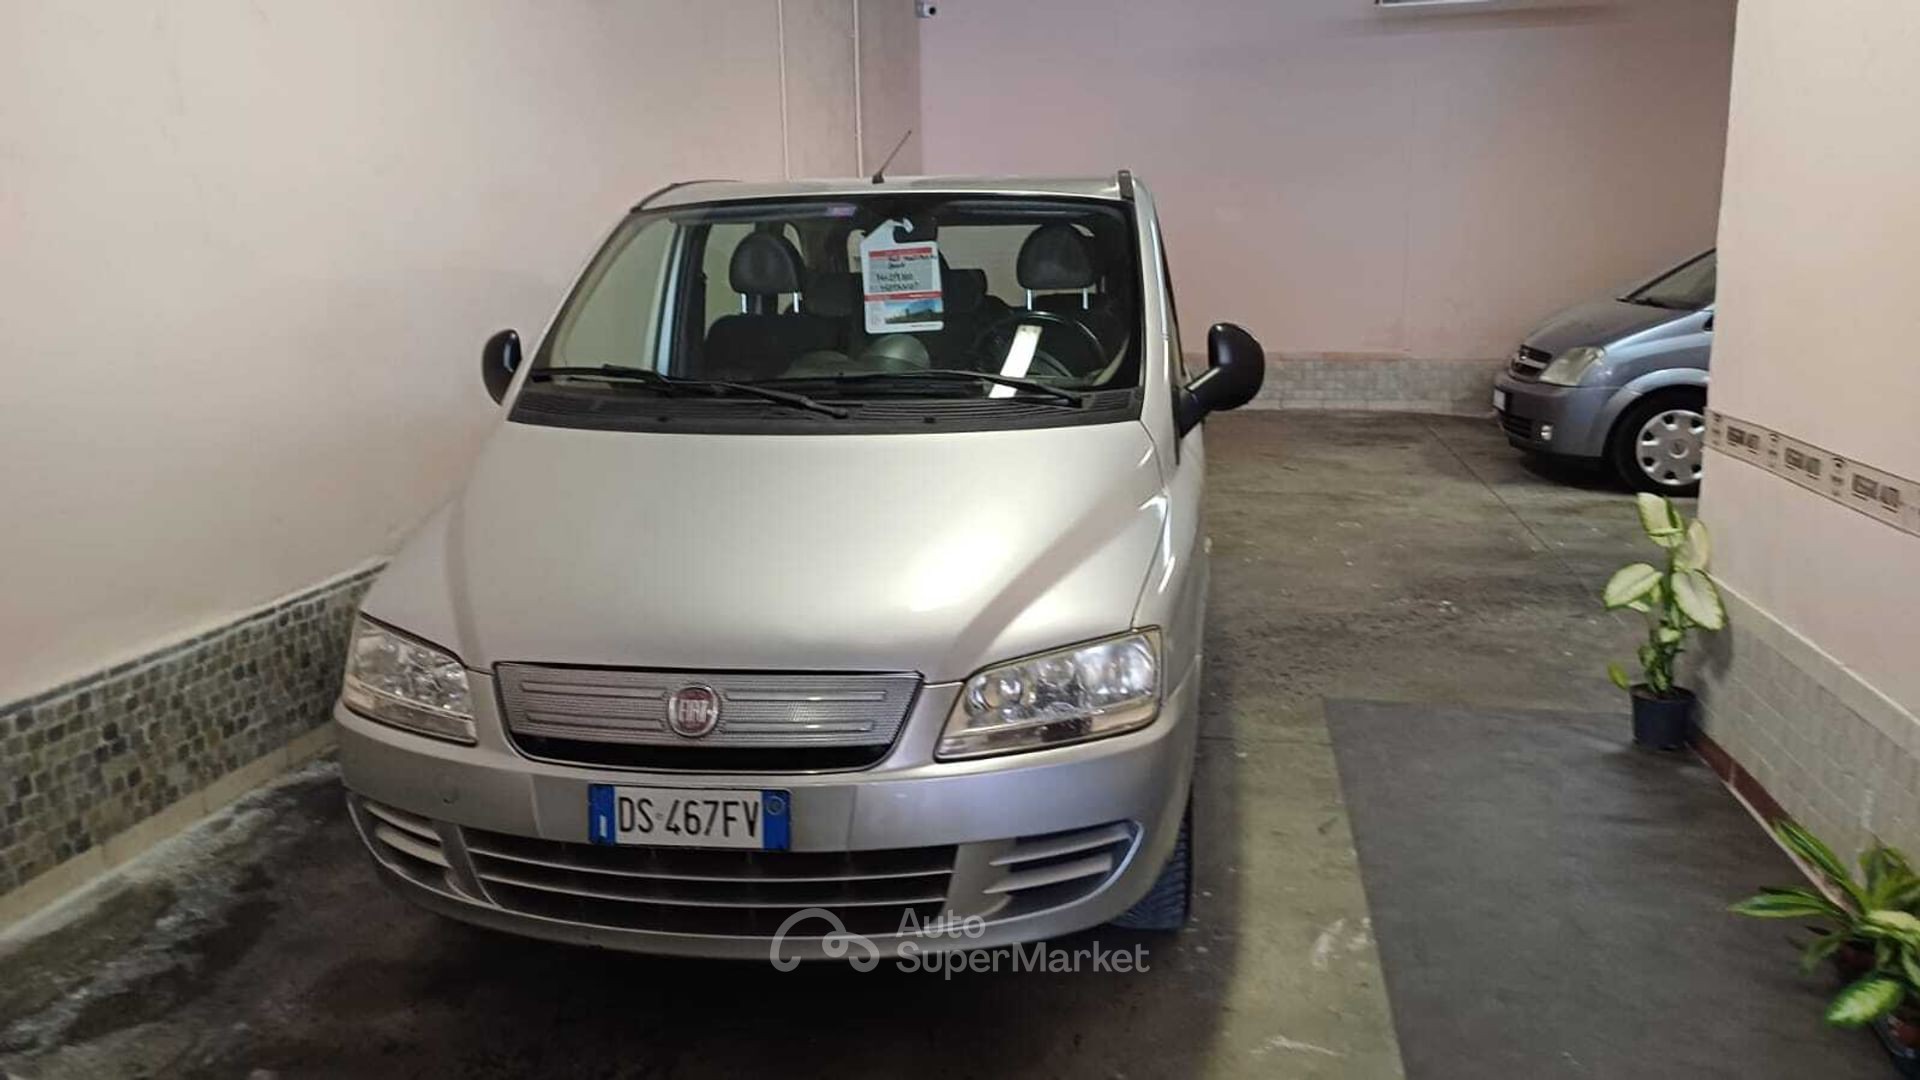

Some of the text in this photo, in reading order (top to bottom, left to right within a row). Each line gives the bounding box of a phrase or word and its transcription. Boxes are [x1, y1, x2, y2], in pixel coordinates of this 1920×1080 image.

[679, 700, 709, 722] FIAT
[619, 797, 759, 838] DS 467FV
